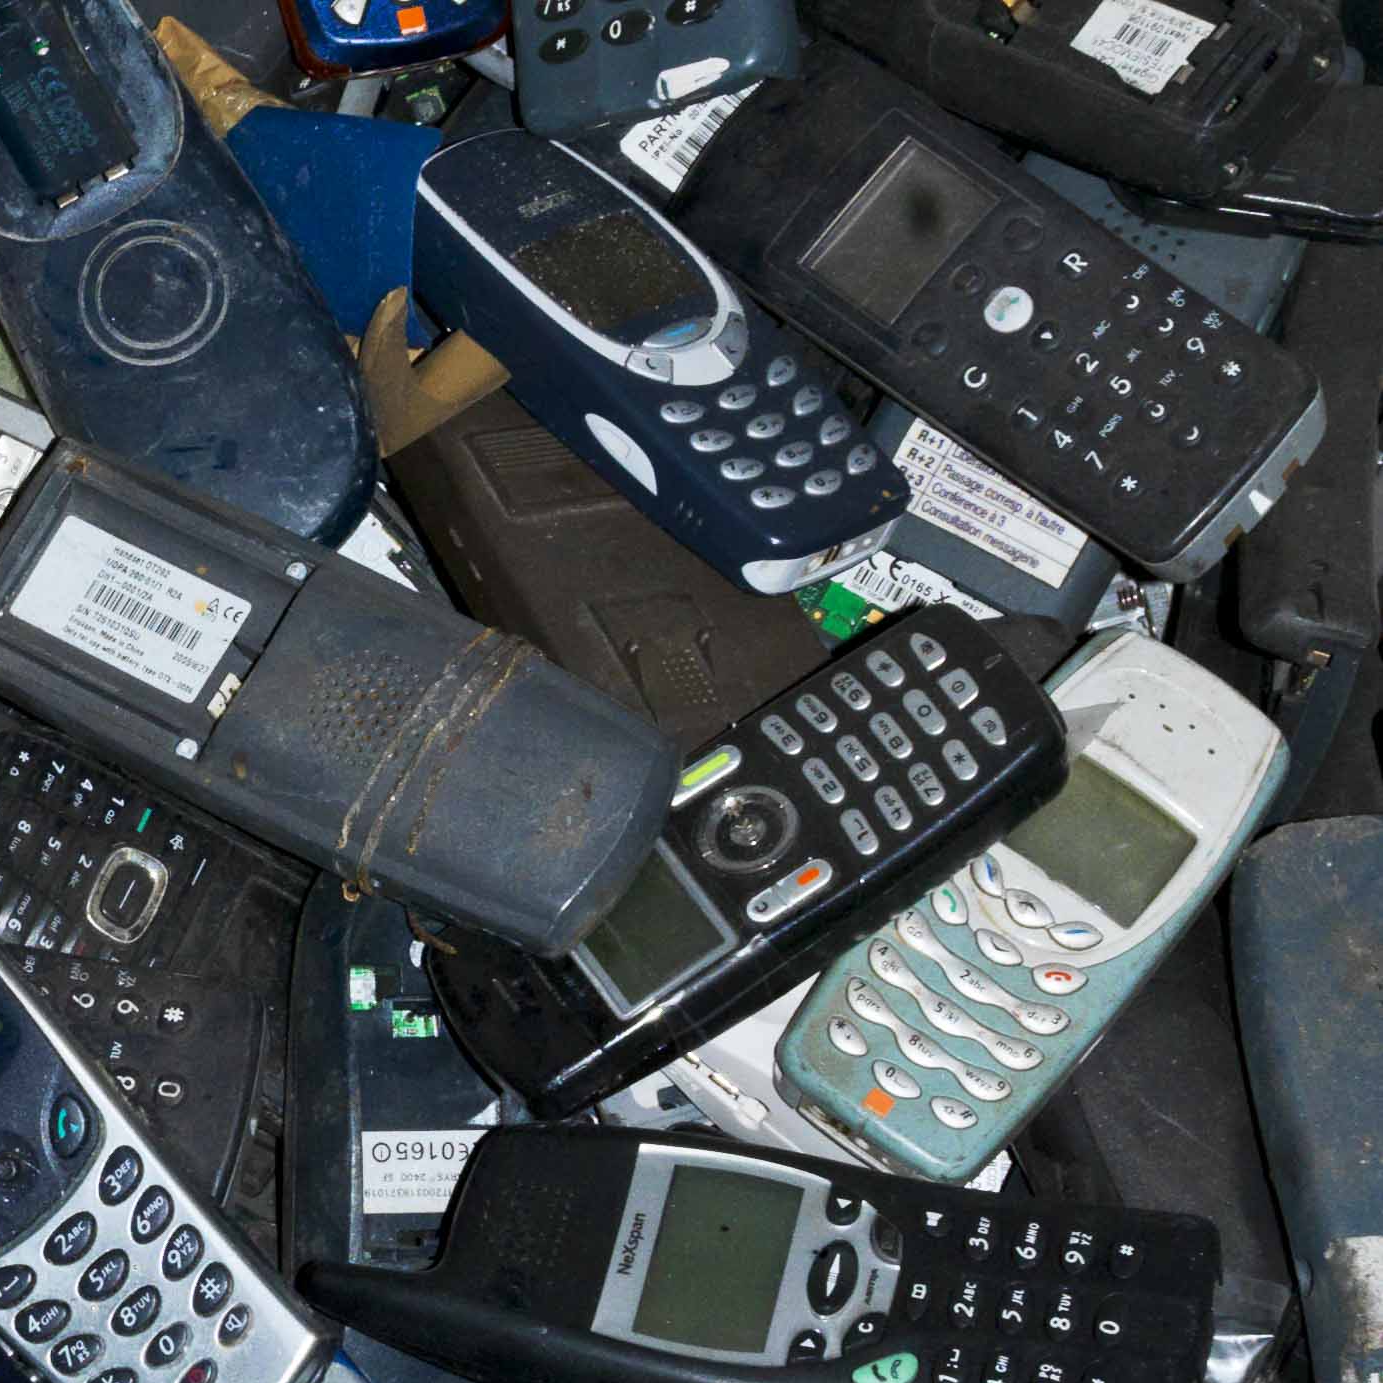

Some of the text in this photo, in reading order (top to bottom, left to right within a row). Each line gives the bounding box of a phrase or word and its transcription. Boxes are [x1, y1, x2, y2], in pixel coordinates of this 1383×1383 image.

[1066, 252, 1088, 274] R
[963, 365, 987, 389] C
[941, 464, 985, 495] Passage
[921, 500, 982, 538] Consultation
[901, 574, 933, 596] 0165
[395, 1141, 454, 1160] 0165
[400, 1172, 425, 1181] 2400
[617, 1210, 647, 1276] NeXspan
[859, 1322, 874, 1334] C
[1099, 1320, 1120, 1335] 0
[158, 1335, 174, 1356] 0
